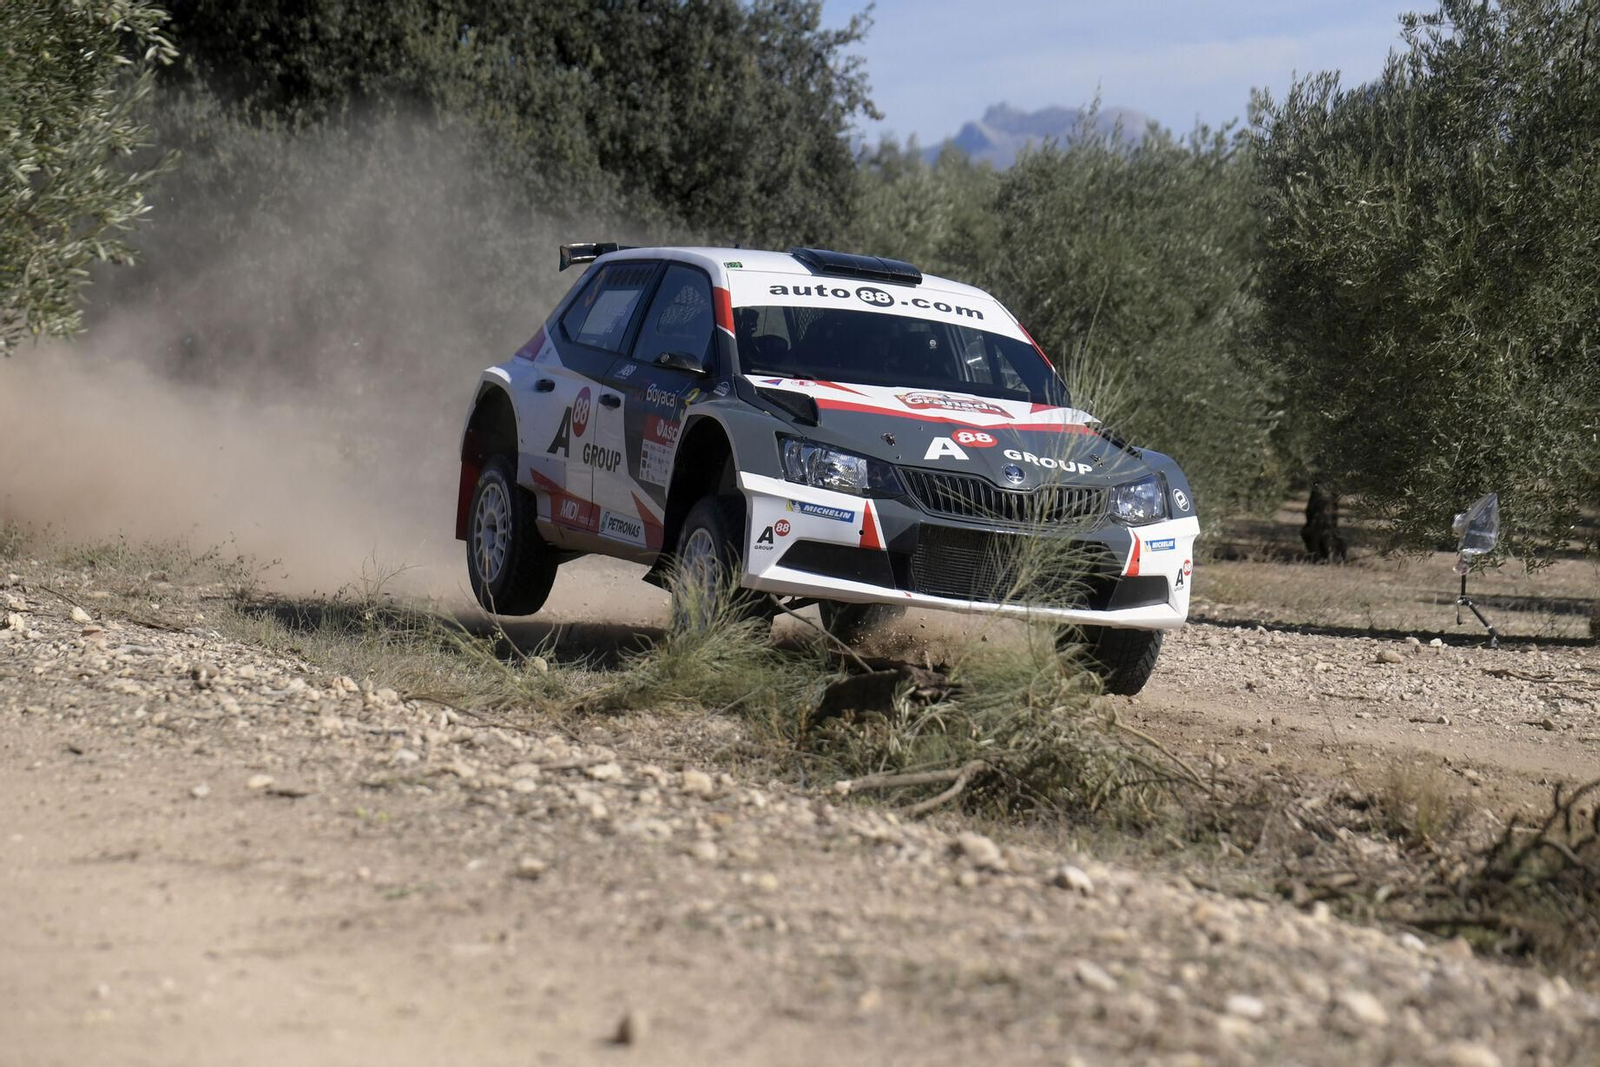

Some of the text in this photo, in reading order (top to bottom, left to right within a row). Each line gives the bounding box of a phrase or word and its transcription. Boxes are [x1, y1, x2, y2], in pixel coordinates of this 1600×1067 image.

[547, 397, 589, 458] A 88
[583, 443, 621, 473] GROUP
[924, 432, 993, 460] A 88
[1003, 449, 1092, 475] GROUP
[803, 504, 851, 520] MICHELIN
[607, 516, 641, 538] PETRONAS
[757, 522, 789, 544] A 88
[1175, 568, 1184, 586] A
